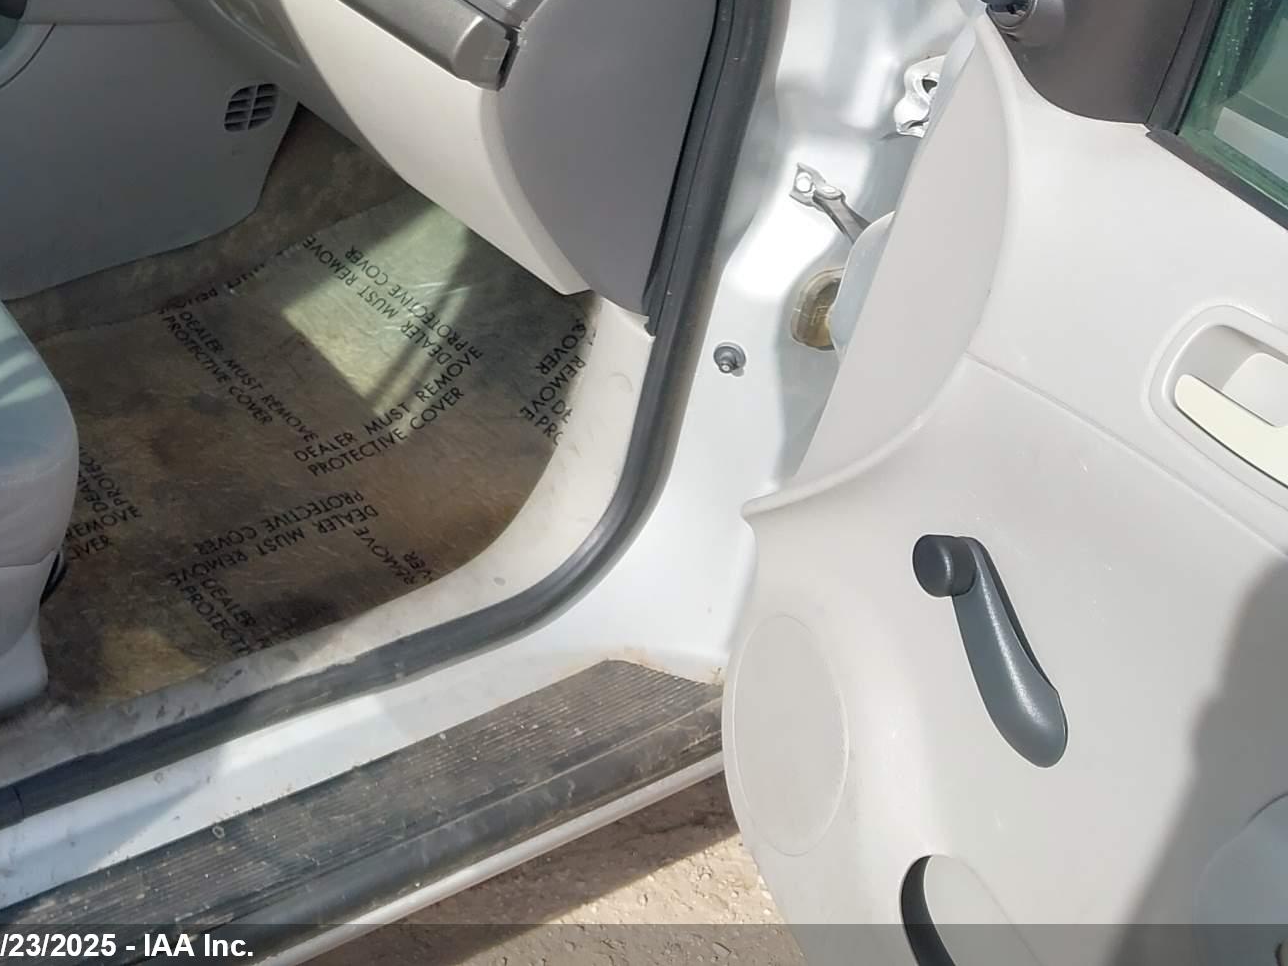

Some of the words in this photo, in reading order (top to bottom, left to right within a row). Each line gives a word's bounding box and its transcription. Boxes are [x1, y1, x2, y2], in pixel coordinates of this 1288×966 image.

[303, 236, 358, 287] REMOVE
[345, 246, 389, 286] COVER
[357, 286, 399, 319] MUST
[388, 284, 470, 352] PROTECTIVE
[400, 321, 453, 365] DEALER
[163, 315, 232, 384] PROTECTIVE
[229, 386, 273, 425] COVER
[179, 311, 224, 354] DEALER
[224, 359, 264, 392] MUST
[262, 394, 319, 442] REMOVE
[519, 355, 586, 421] REMOVE
[294, 432, 358, 462] DEALER
[363, 402, 411, 435] MUST
[415, 346, 484, 402] REMOVE
[307, 428, 408, 477] PROTECTIVE
[409, 386, 465, 430] COVER
[265, 490, 365, 533] PROTECTIVE
[316, 504, 379, 535] DEALER
[194, 526, 258, 555] COVER
[255, 527, 306, 556] MUST
[353, 527, 415, 585] REMOVE
[167, 551, 249, 585] REMOVE
[202, 579, 256, 627] DEALER
